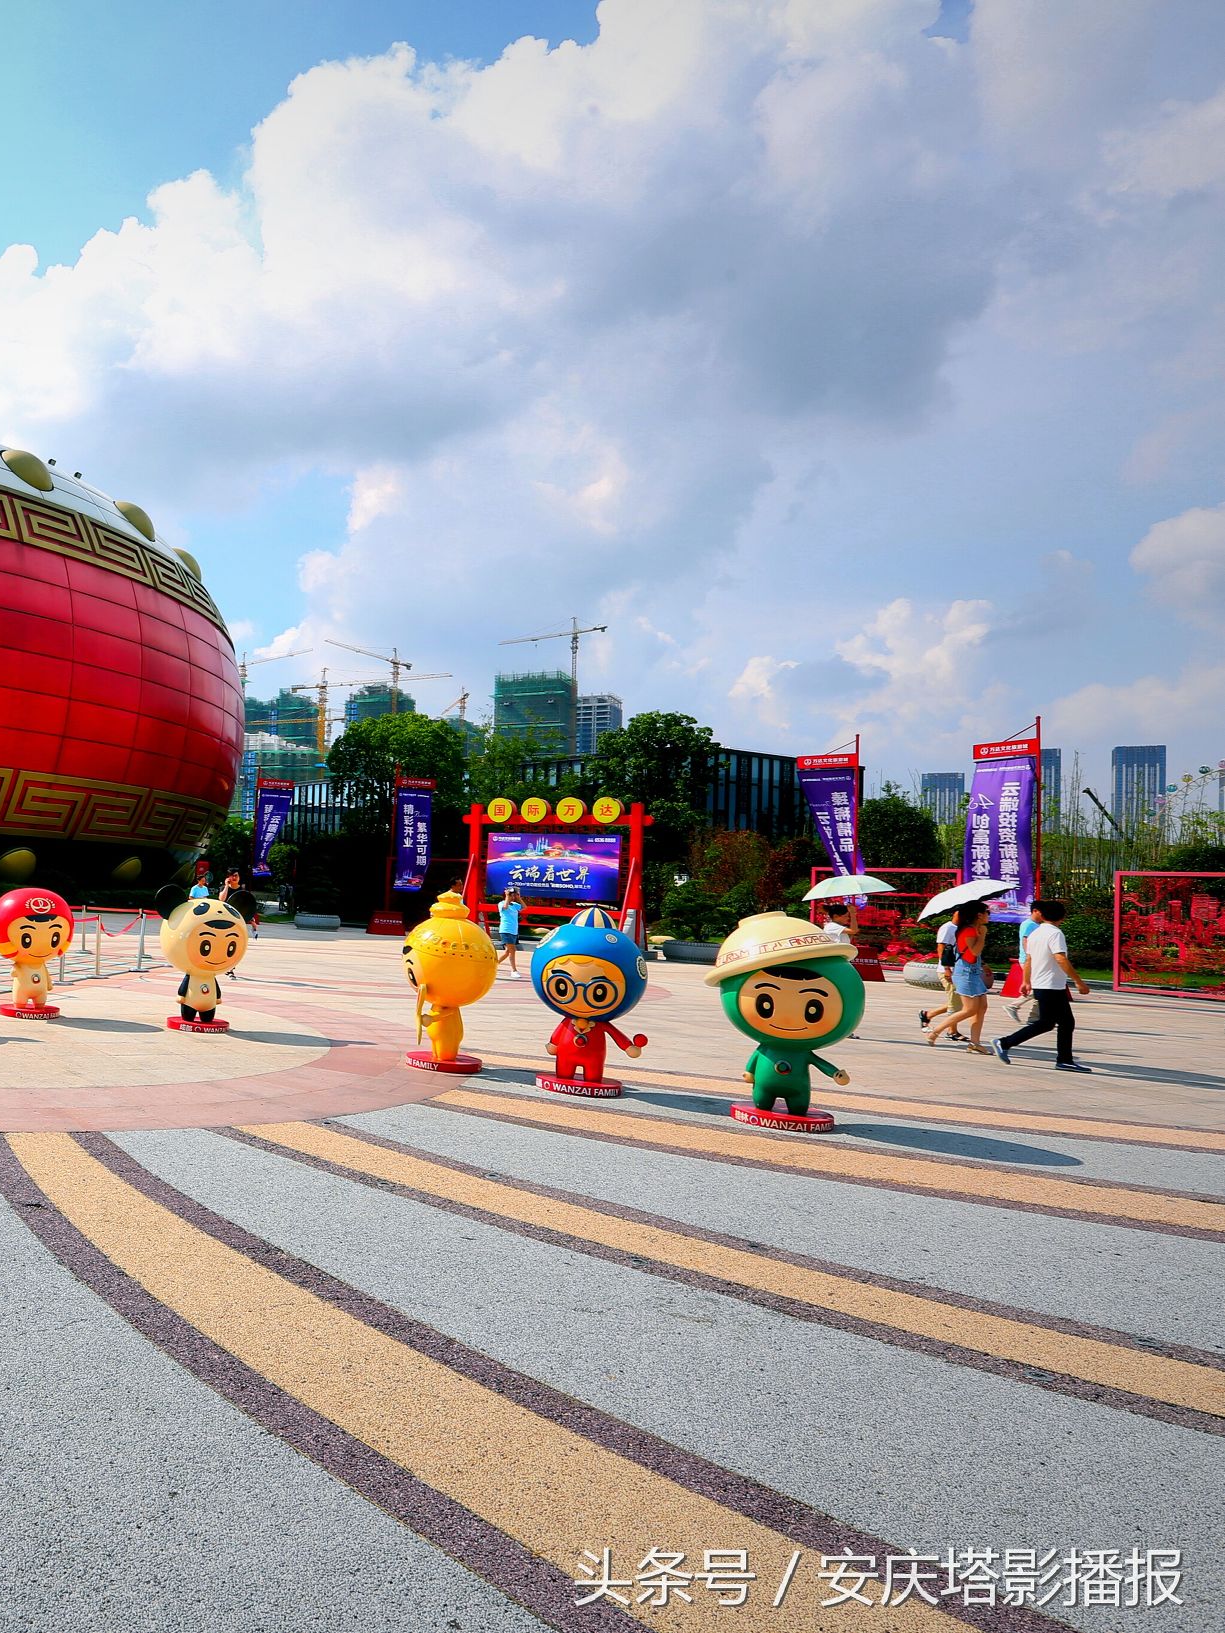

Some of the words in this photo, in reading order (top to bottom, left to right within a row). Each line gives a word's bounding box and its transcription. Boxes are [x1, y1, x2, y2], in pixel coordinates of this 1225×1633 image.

[402, 803, 415, 848] 精彩开业
[416, 822, 428, 867] 繁华可期
[508, 864, 590, 885] 云端看世界
[412, 1059, 439, 1071] FAMILY
[552, 1082, 592, 1096] WANZAI
[760, 1117, 808, 1132] WANZAI
